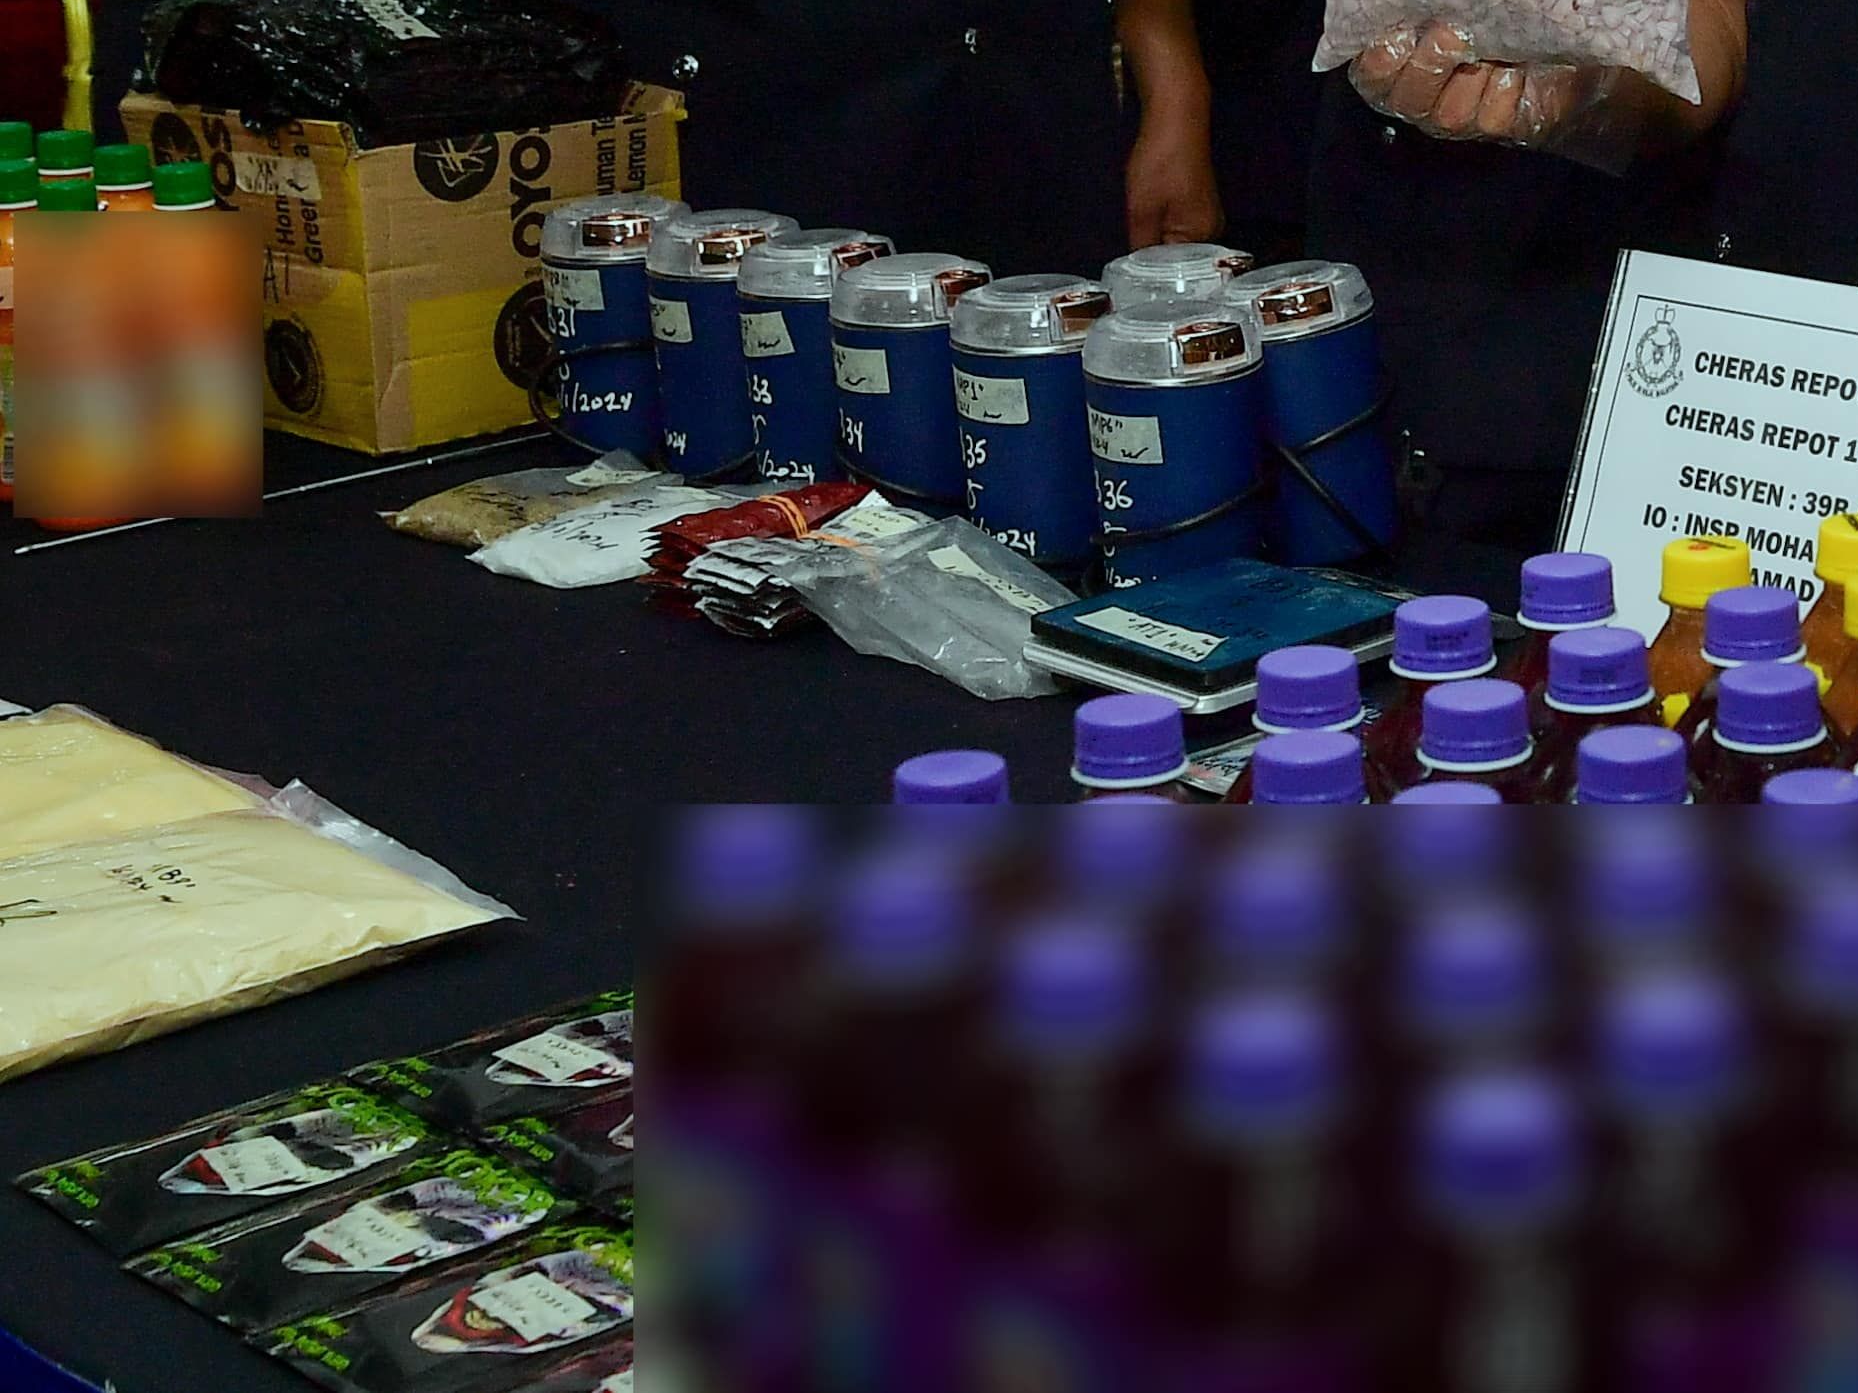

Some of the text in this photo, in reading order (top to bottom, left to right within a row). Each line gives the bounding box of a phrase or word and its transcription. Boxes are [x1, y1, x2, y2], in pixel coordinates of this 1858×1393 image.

[621, 127, 647, 194] Lemon
[1694, 351, 1786, 389] CHERAS
[1664, 403, 1756, 442] CHERAS
[1760, 422, 1841, 459] REPOT
[1678, 465, 1785, 508] SEKSYEN
[1643, 504, 1668, 528] IO
[1684, 512, 1741, 538] INSP
